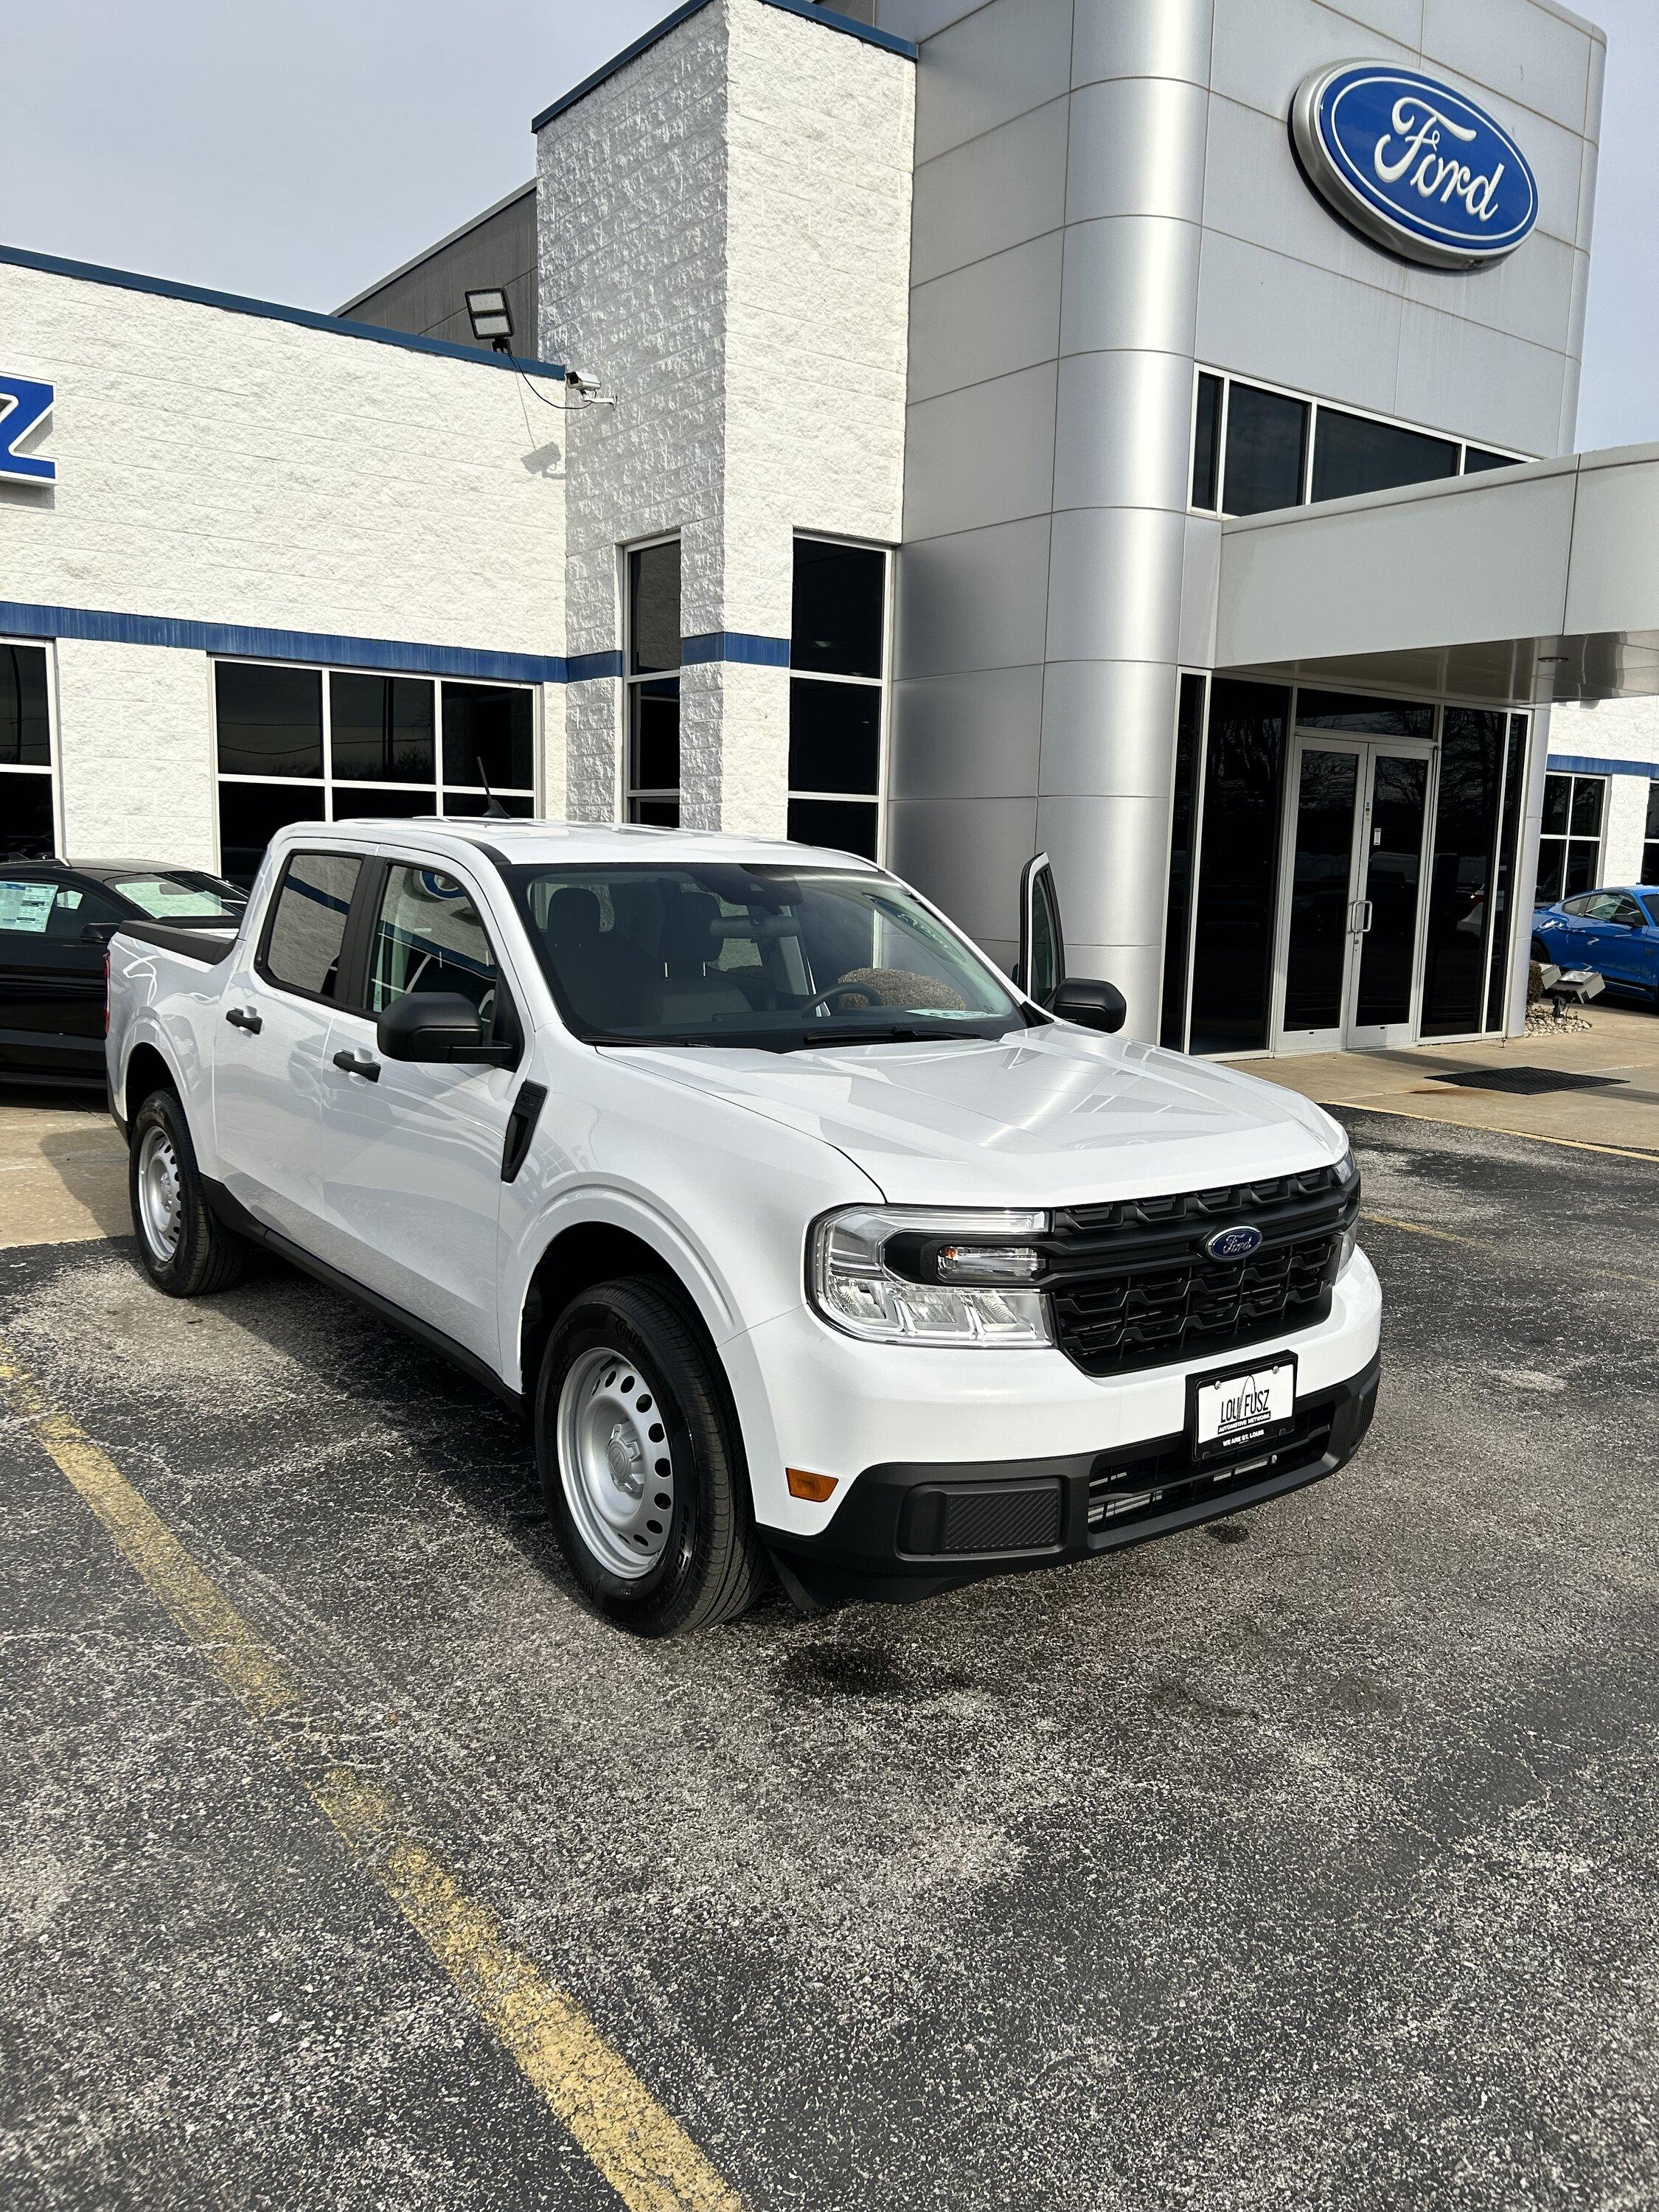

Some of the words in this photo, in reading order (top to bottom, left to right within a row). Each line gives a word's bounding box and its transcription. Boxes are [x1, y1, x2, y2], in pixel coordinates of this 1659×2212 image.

[1374, 97, 1505, 222] Ford
[1222, 1233, 1252, 1254] Ford
[1220, 1397, 1240, 1424] LOU
[1244, 1389, 1270, 1416] FUSZ
[1218, 1419, 1247, 1433] AUTOMOTIVE
[1248, 1413, 1270, 1425] NETWORK
[1222, 1439, 1231, 1447] WE
[1231, 1436, 1241, 1444] ARE
[1250, 1429, 1265, 1439] LOUIS
